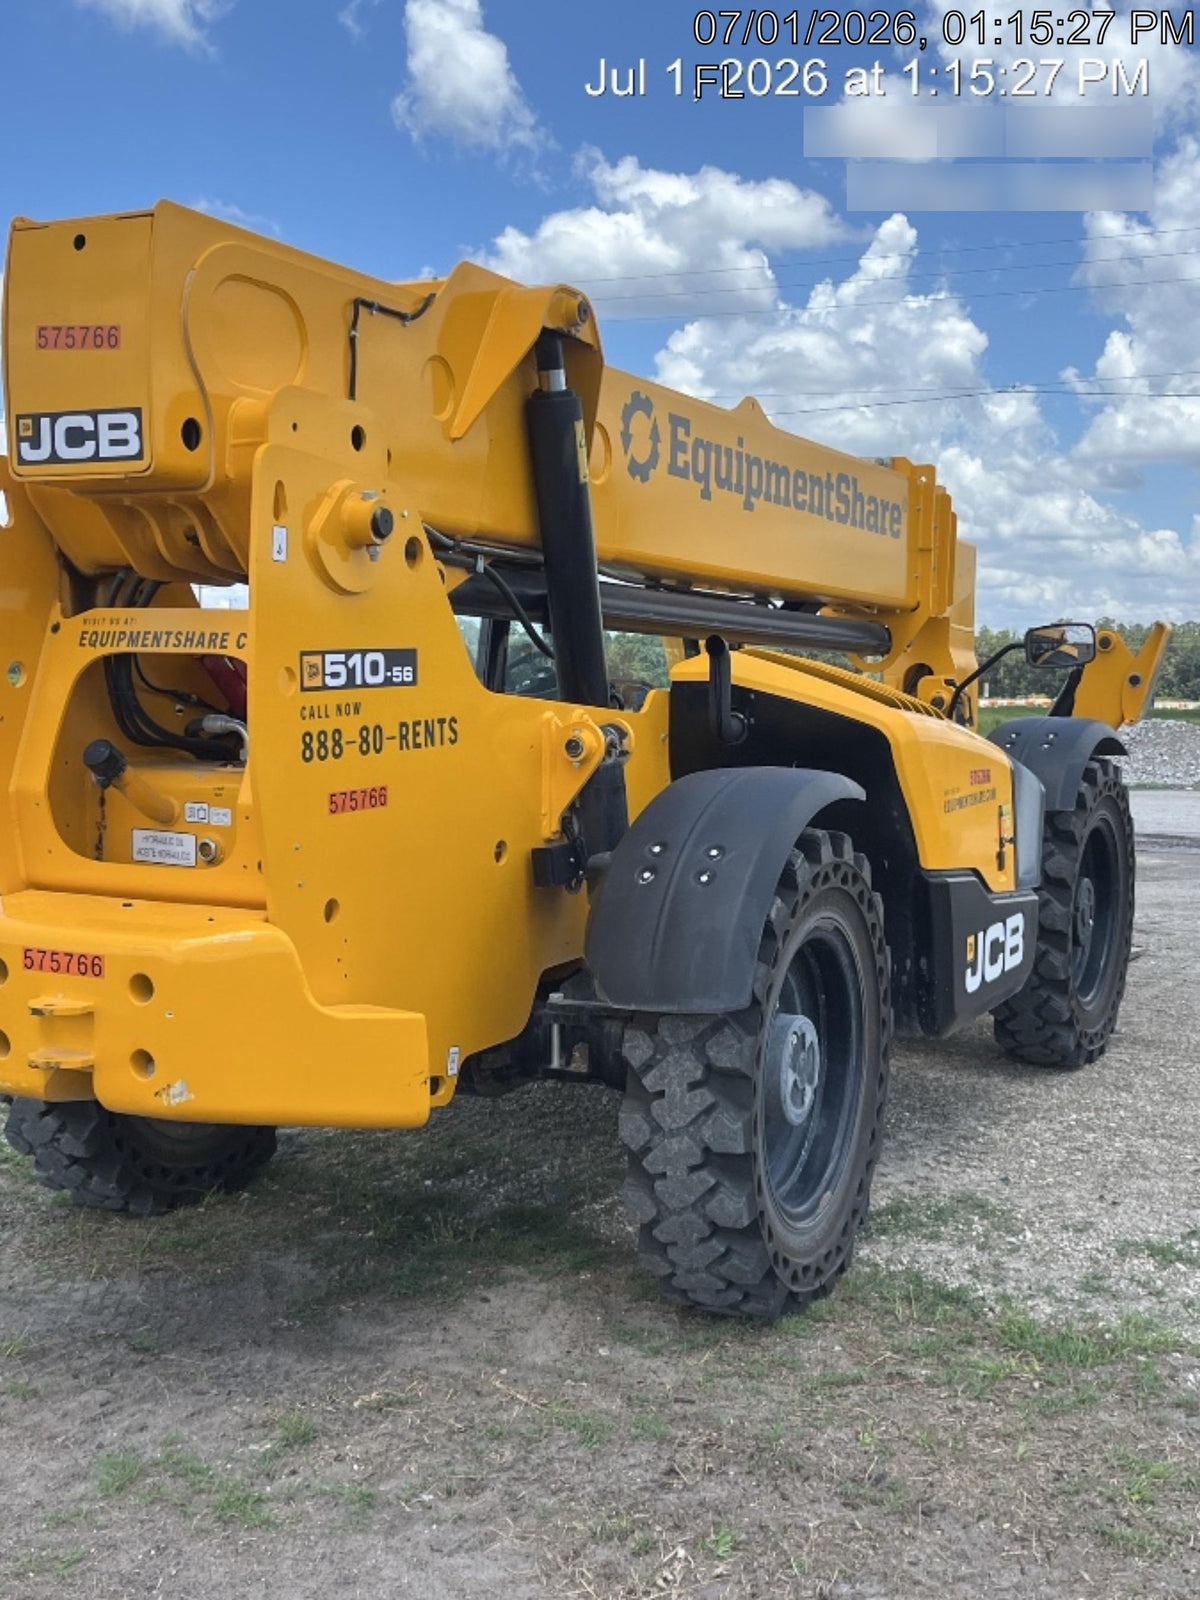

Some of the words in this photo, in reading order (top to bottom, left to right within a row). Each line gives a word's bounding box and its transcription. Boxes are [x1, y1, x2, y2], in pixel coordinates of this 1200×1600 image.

[37, 326, 119, 350] 575766
[19, 412, 141, 462] JCB
[667, 412, 902, 540] EquipmentShare
[79, 630, 230, 650] EQUIPMENTSHARE
[300, 704, 330, 721] CALL
[336, 702, 362, 717] NOW
[301, 716, 459, 764] 888-80-RENTS
[329, 786, 388, 815] 575766
[23, 948, 103, 978] 575766
[965, 913, 1025, 993] JCB
